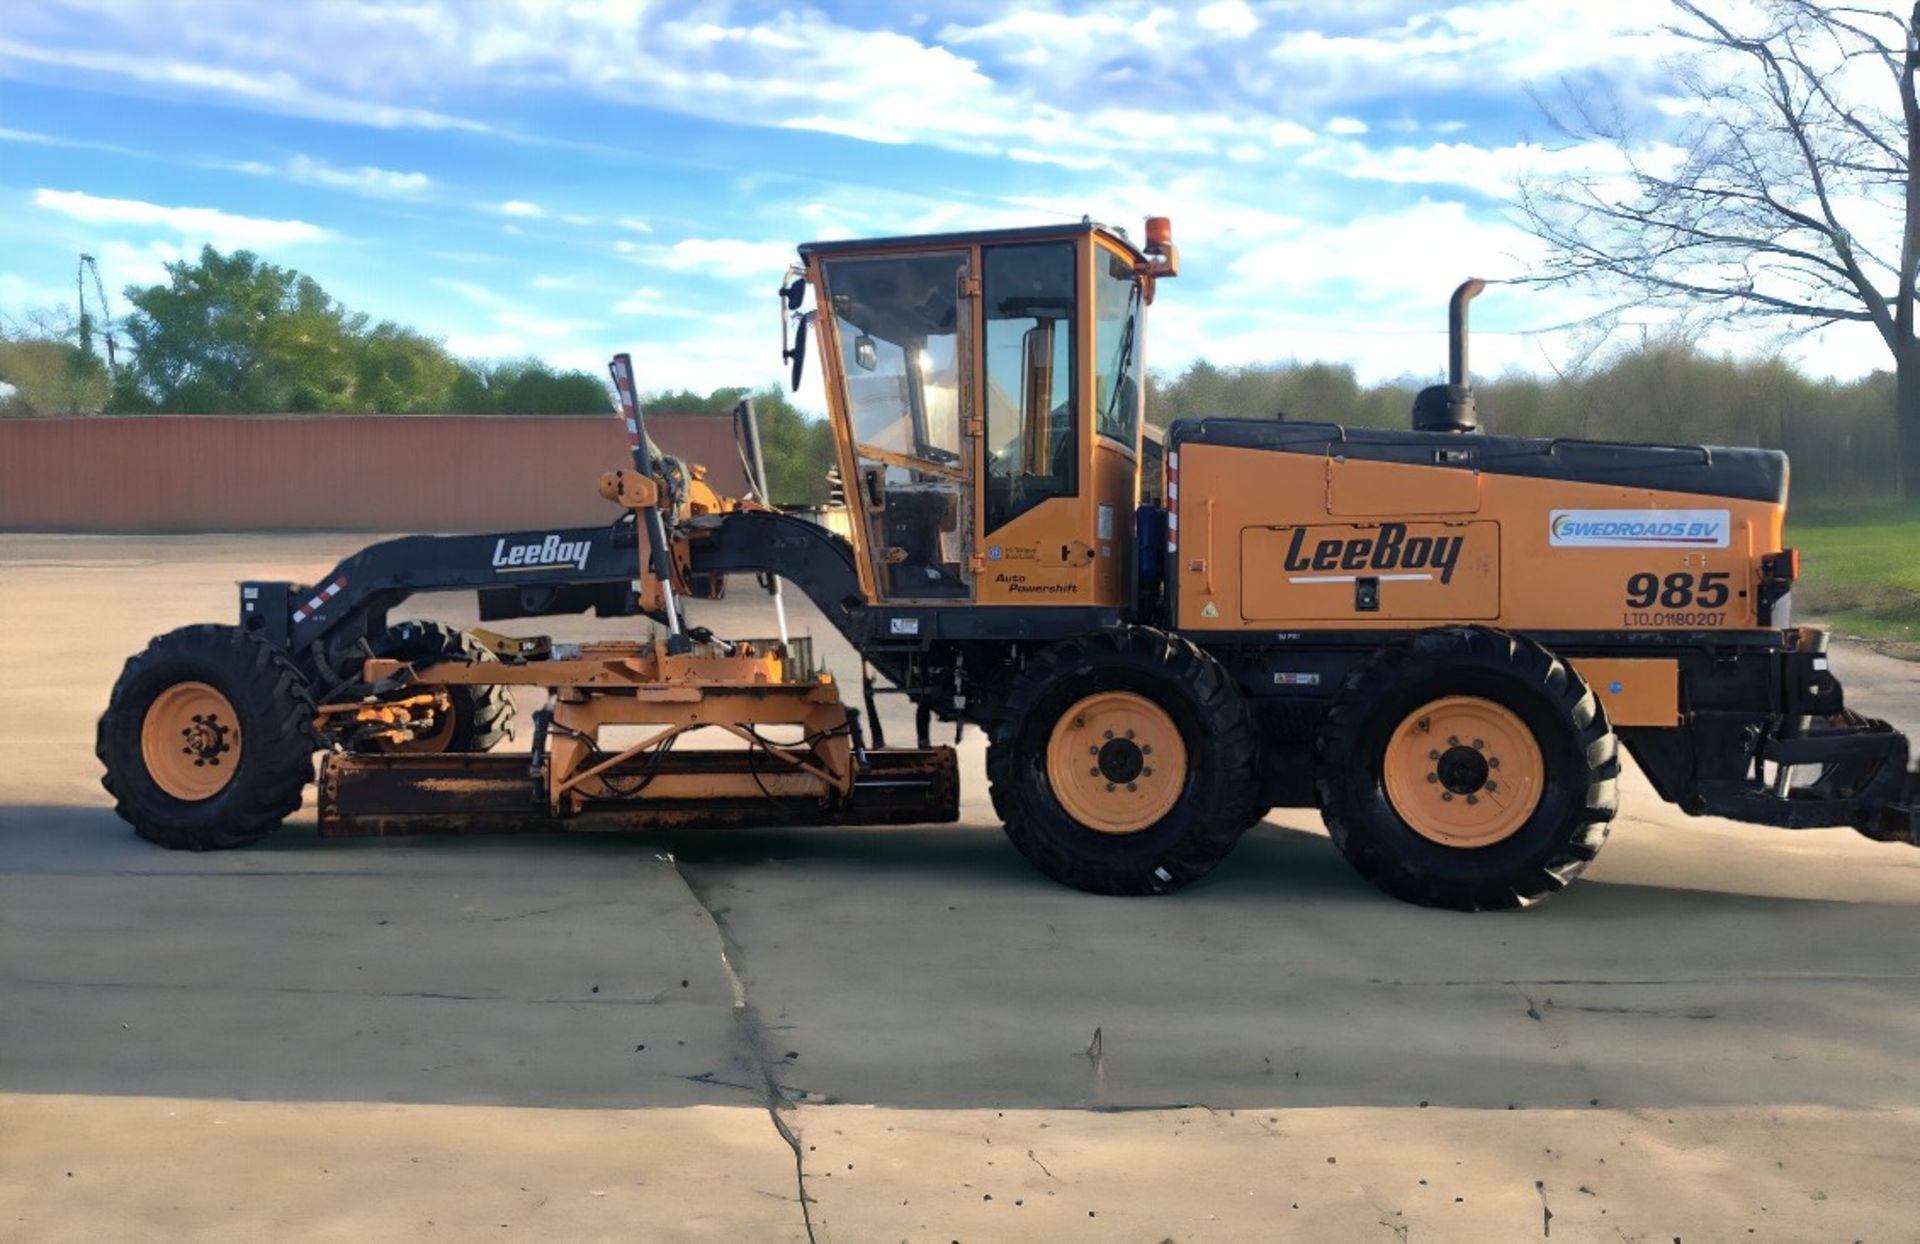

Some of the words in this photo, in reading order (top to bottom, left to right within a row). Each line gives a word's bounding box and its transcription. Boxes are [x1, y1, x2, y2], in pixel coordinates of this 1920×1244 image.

[1561, 522, 1687, 536] SWEDROADS
[1687, 522, 1719, 536] BV
[492, 535, 592, 570] LeeBoy
[1284, 522, 1464, 584] LeeBoy
[995, 573, 1026, 583] Auto
[1008, 583, 1078, 593] Powershift
[1625, 572, 1730, 609] 985
